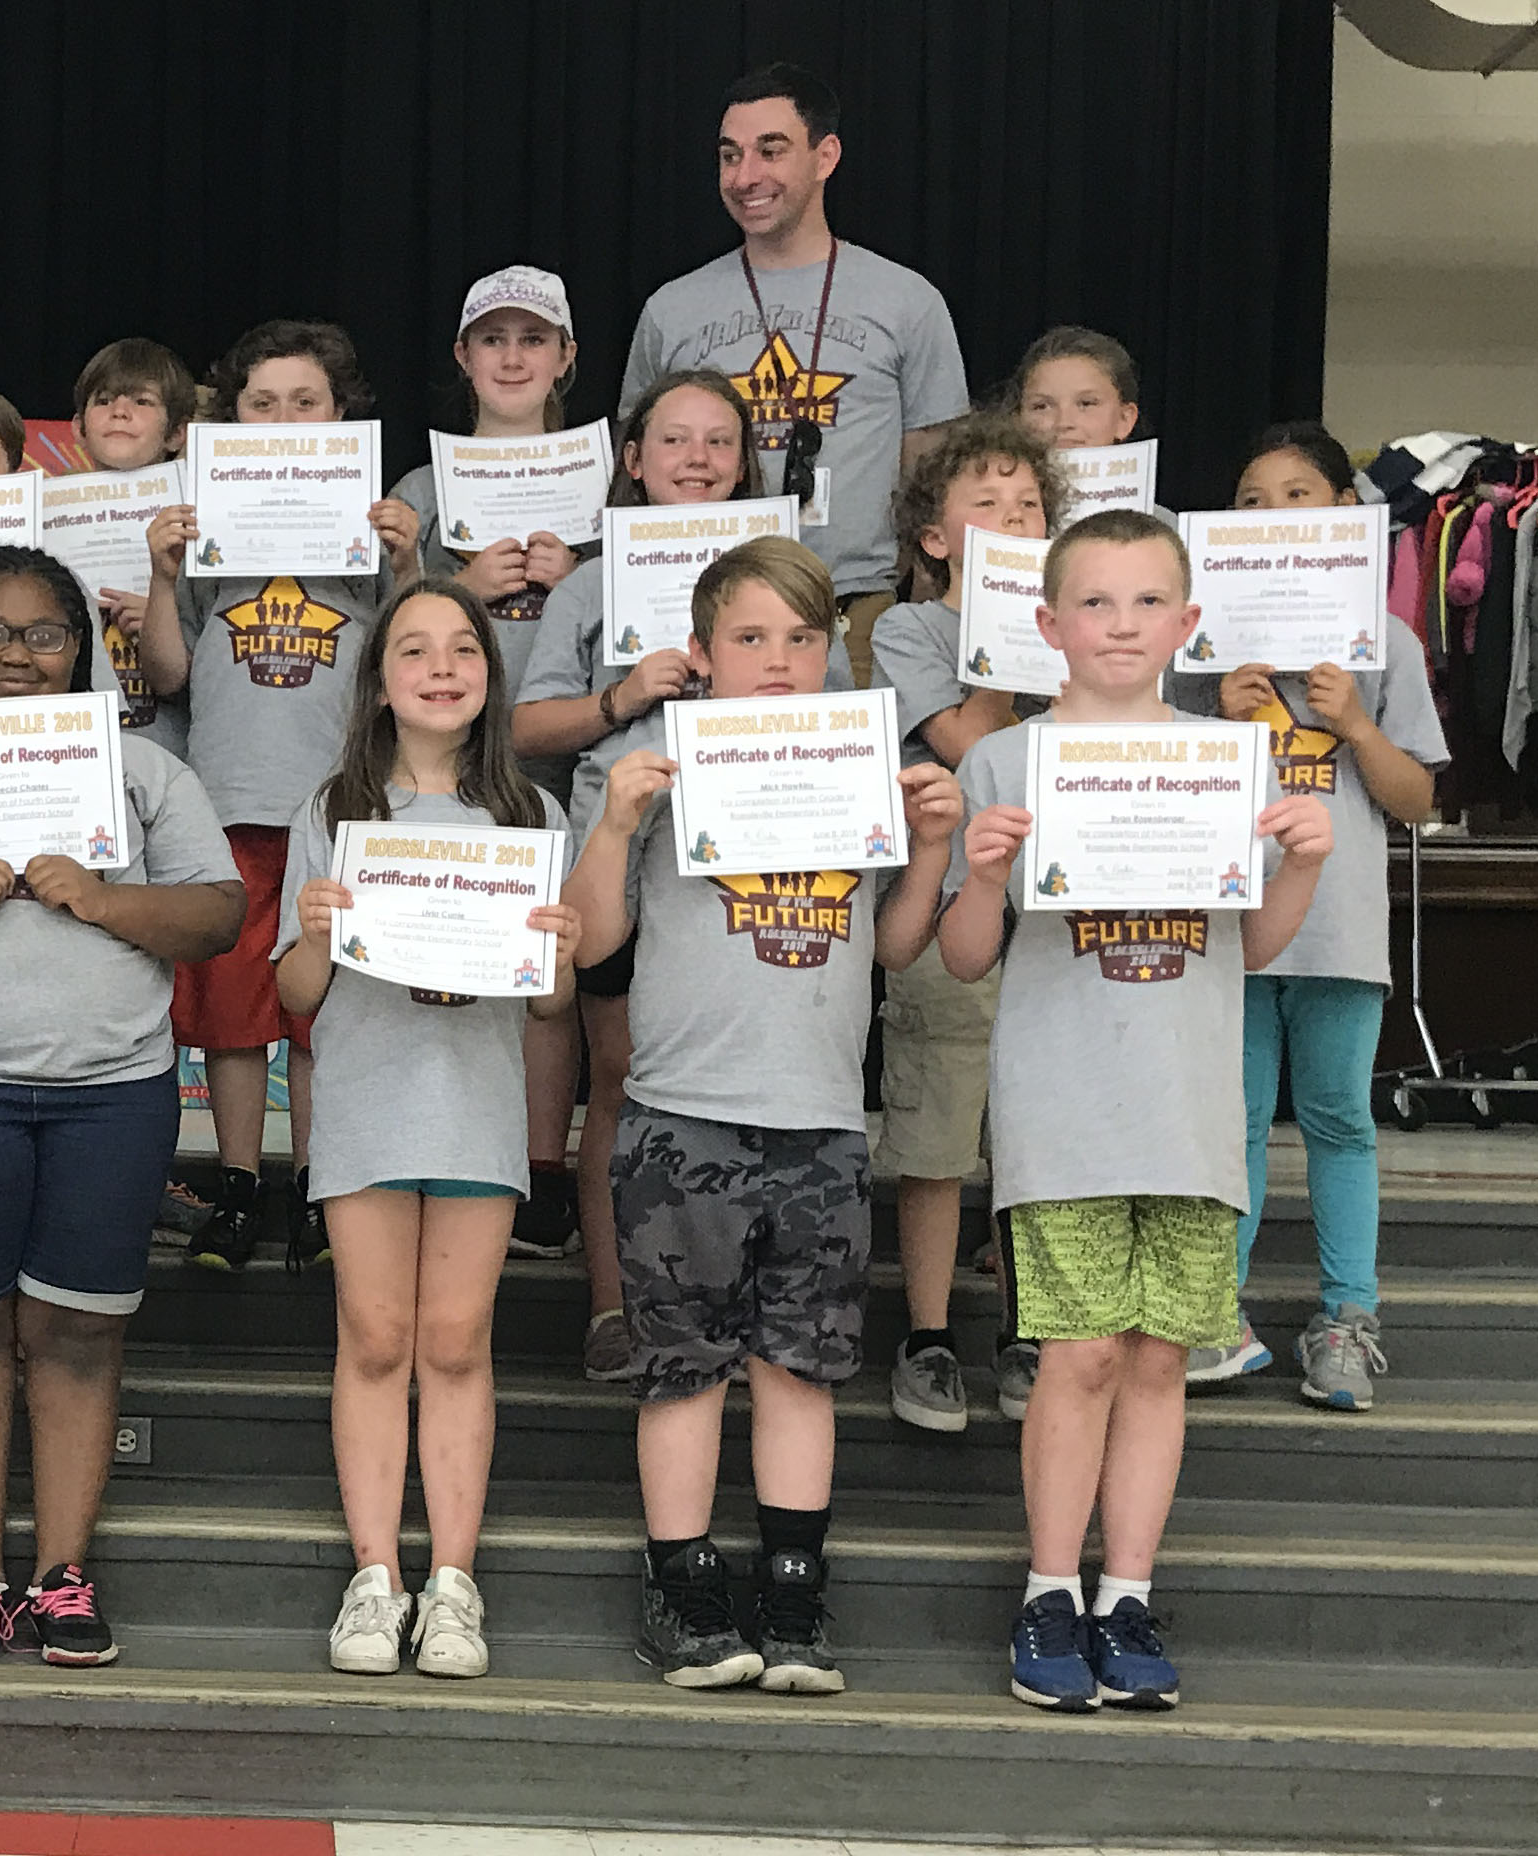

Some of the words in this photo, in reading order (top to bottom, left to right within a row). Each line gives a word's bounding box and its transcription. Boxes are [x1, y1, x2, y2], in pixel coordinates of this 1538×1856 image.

[211, 468, 272, 481] Certificate
[276, 467, 288, 480] of
[292, 466, 361, 482] Recognition
[453, 467, 511, 479] Certificate
[514, 468, 525, 478] of
[529, 458, 595, 477] Recognition
[43, 483, 131, 508] OESSLEVILLE
[43, 512, 92, 530] ertificate
[97, 510, 106, 523] of
[110, 504, 162, 522] Recogniti
[627, 551, 692, 565] Certificate
[697, 549, 708, 562] of
[1203, 557, 1271, 571] Certificate
[1276, 555, 1288, 569] of
[1293, 554, 1368, 570] Recognition
[235, 635, 334, 663] FUTURE
[54, 711, 92, 733] 2018
[696, 712, 820, 737] ROESSLEVILLE
[829, 709, 869, 730] 2018
[1, 749, 14, 764] of
[18, 744, 98, 764] Recognition
[695, 749, 769, 764] Certificate
[774, 746, 787, 762] of
[792, 743, 874, 762] Recognition
[1059, 741, 1187, 762] ROESSLEVILLE
[1197, 741, 1239, 762] 2018
[1055, 776, 1132, 792] Certificate
[1137, 776, 1151, 792] of
[1156, 776, 1240, 796] Recognition
[364, 837, 487, 863] ROESSLEVILLE
[495, 844, 536, 867] 2018
[358, 869, 431, 888] Certificate
[435, 874, 449, 888] of
[453, 875, 536, 896] Recognition
[732, 902, 849, 936] FUTURE
[1078, 920, 1204, 950] FUTURE
